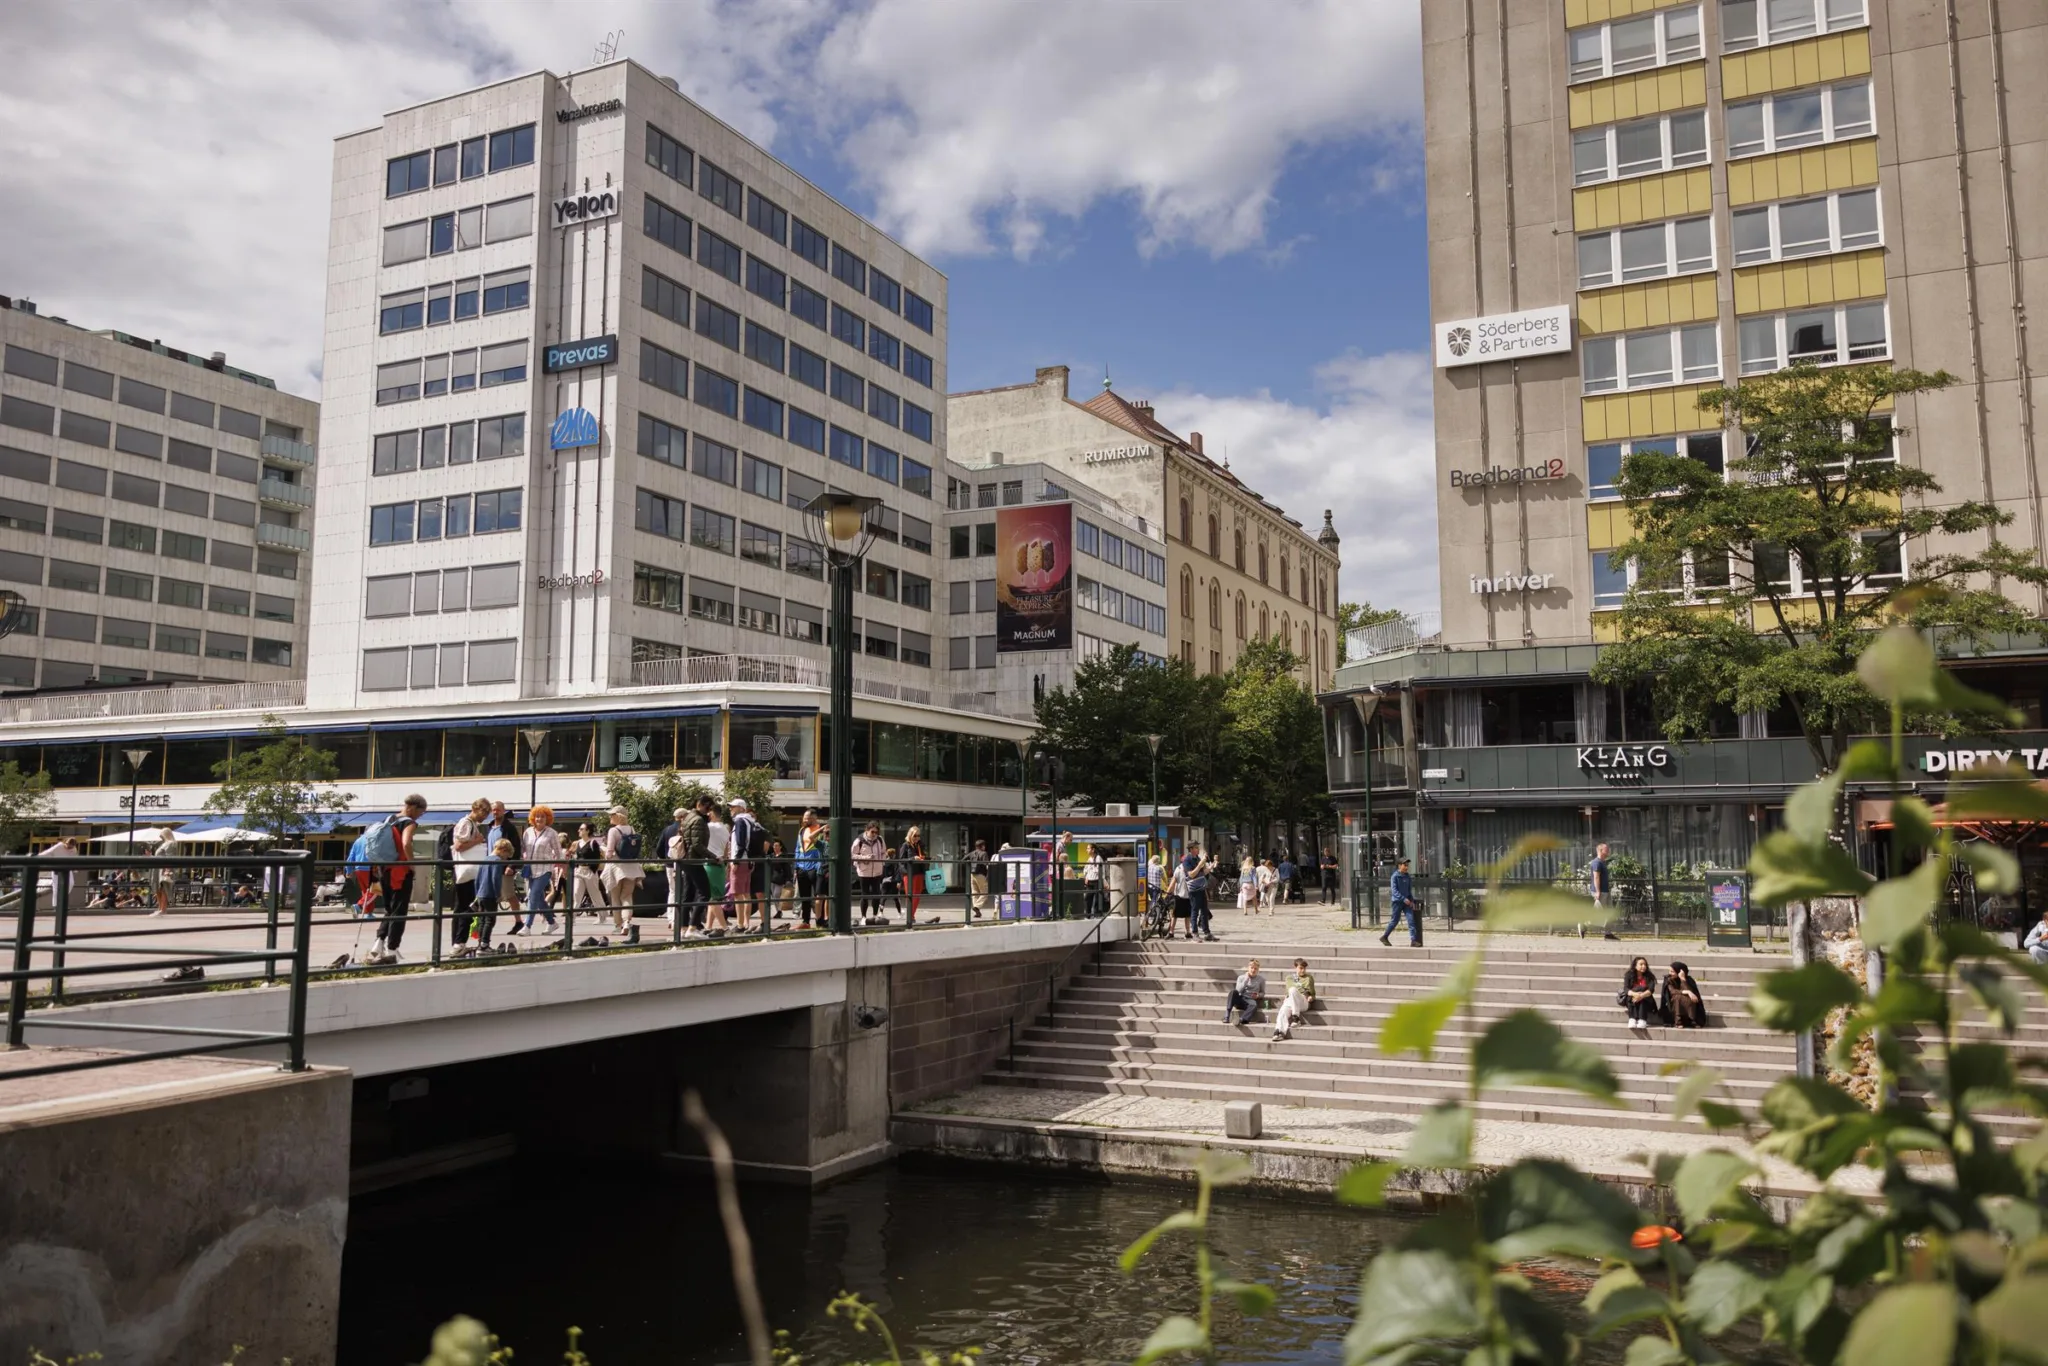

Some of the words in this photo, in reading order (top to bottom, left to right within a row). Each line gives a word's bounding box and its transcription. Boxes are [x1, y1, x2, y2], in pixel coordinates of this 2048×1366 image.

[554, 193, 613, 223] Yellon
[1478, 317, 1559, 338] Söderberg
[1479, 340, 1491, 354] &
[1494, 334, 1558, 352] Partners
[549, 344, 608, 368] Prevas
[1085, 444, 1149, 462] RUMRUM
[1450, 458, 1564, 488] Bredband2
[538, 569, 604, 589] Bredband2
[1470, 570, 1554, 593] inriver
[1013, 629, 1056, 640] MAGNUM
[619, 736, 651, 763] BK
[752, 735, 790, 761] BK
[1576, 746, 1667, 768] KLANG
[1926, 750, 2013, 772] DIRTY
[120, 796, 134, 808] BIG
[139, 794, 170, 807] APPLE
